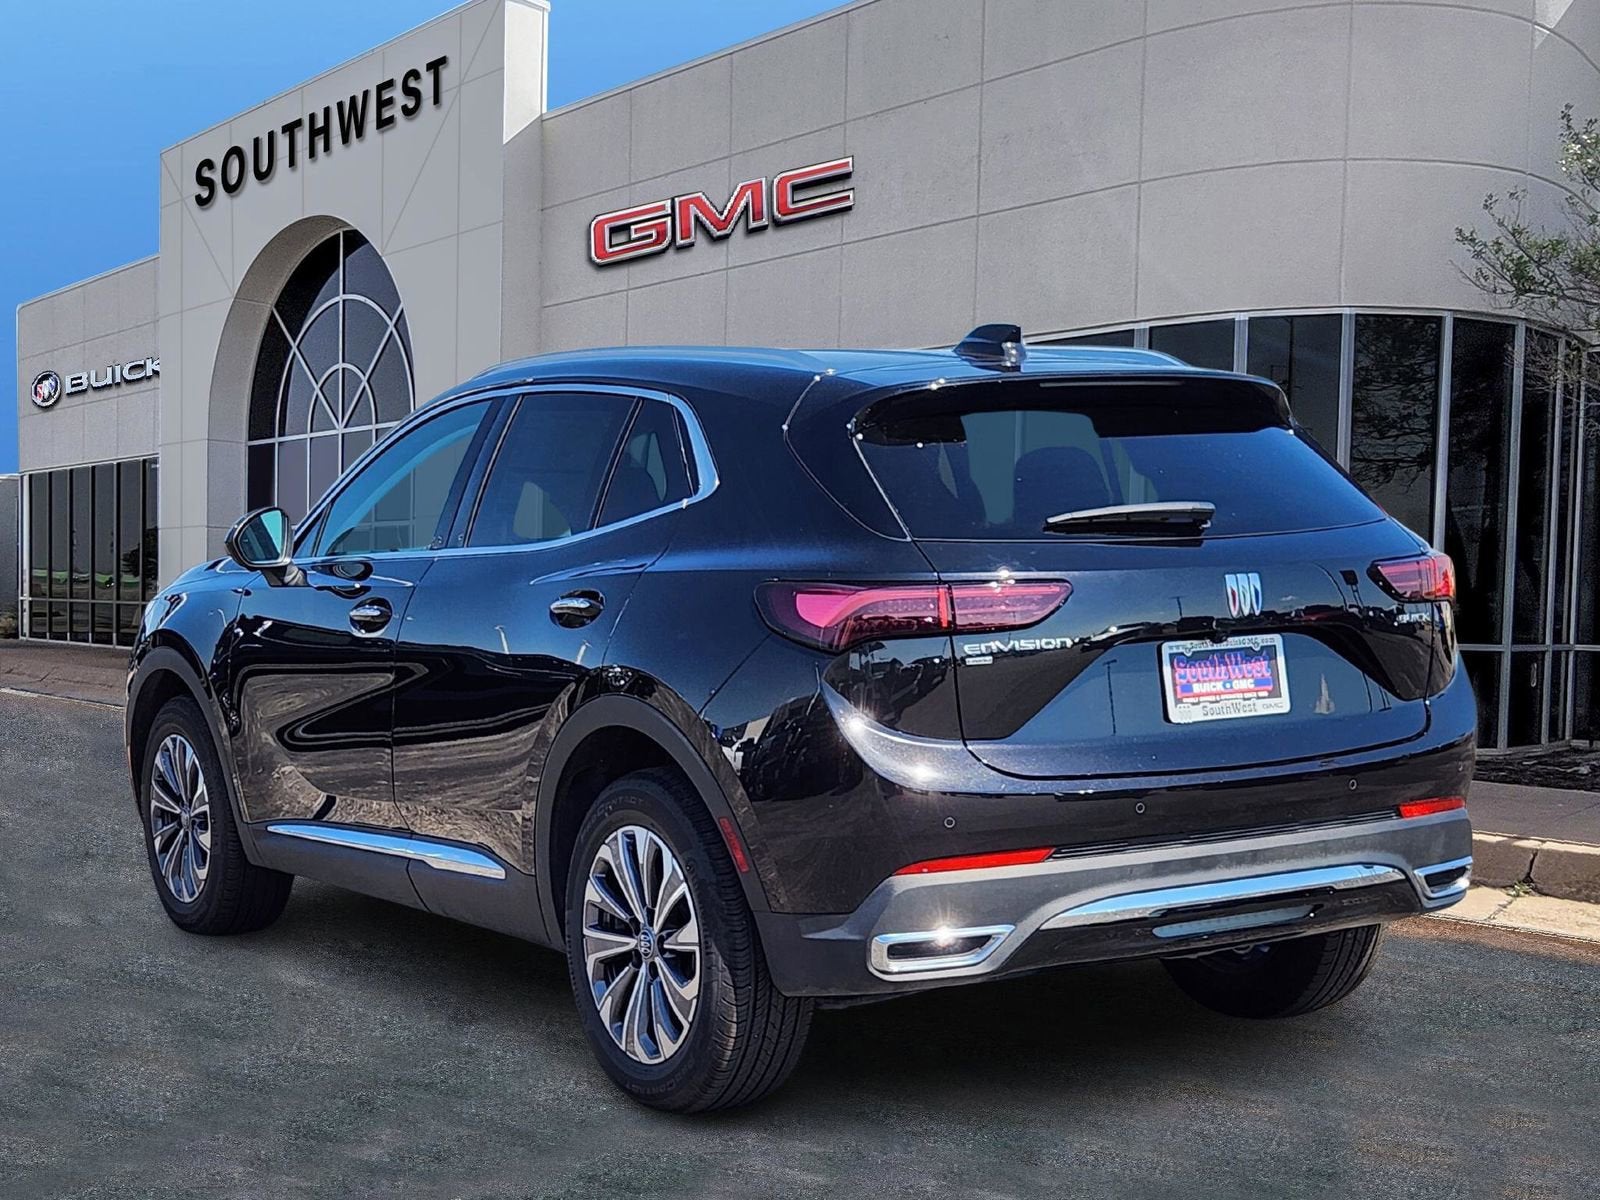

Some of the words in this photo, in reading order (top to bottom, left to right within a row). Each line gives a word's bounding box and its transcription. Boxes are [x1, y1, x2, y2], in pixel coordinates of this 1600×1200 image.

[194, 55, 448, 208] SOUTHWEST
[589, 155, 855, 266] GMC
[64, 357, 160, 395] BUICK
[1192, 680, 1223, 693] BUICK
[1232, 678, 1255, 690] GMC
[1202, 702, 1258, 717] SouthWest
